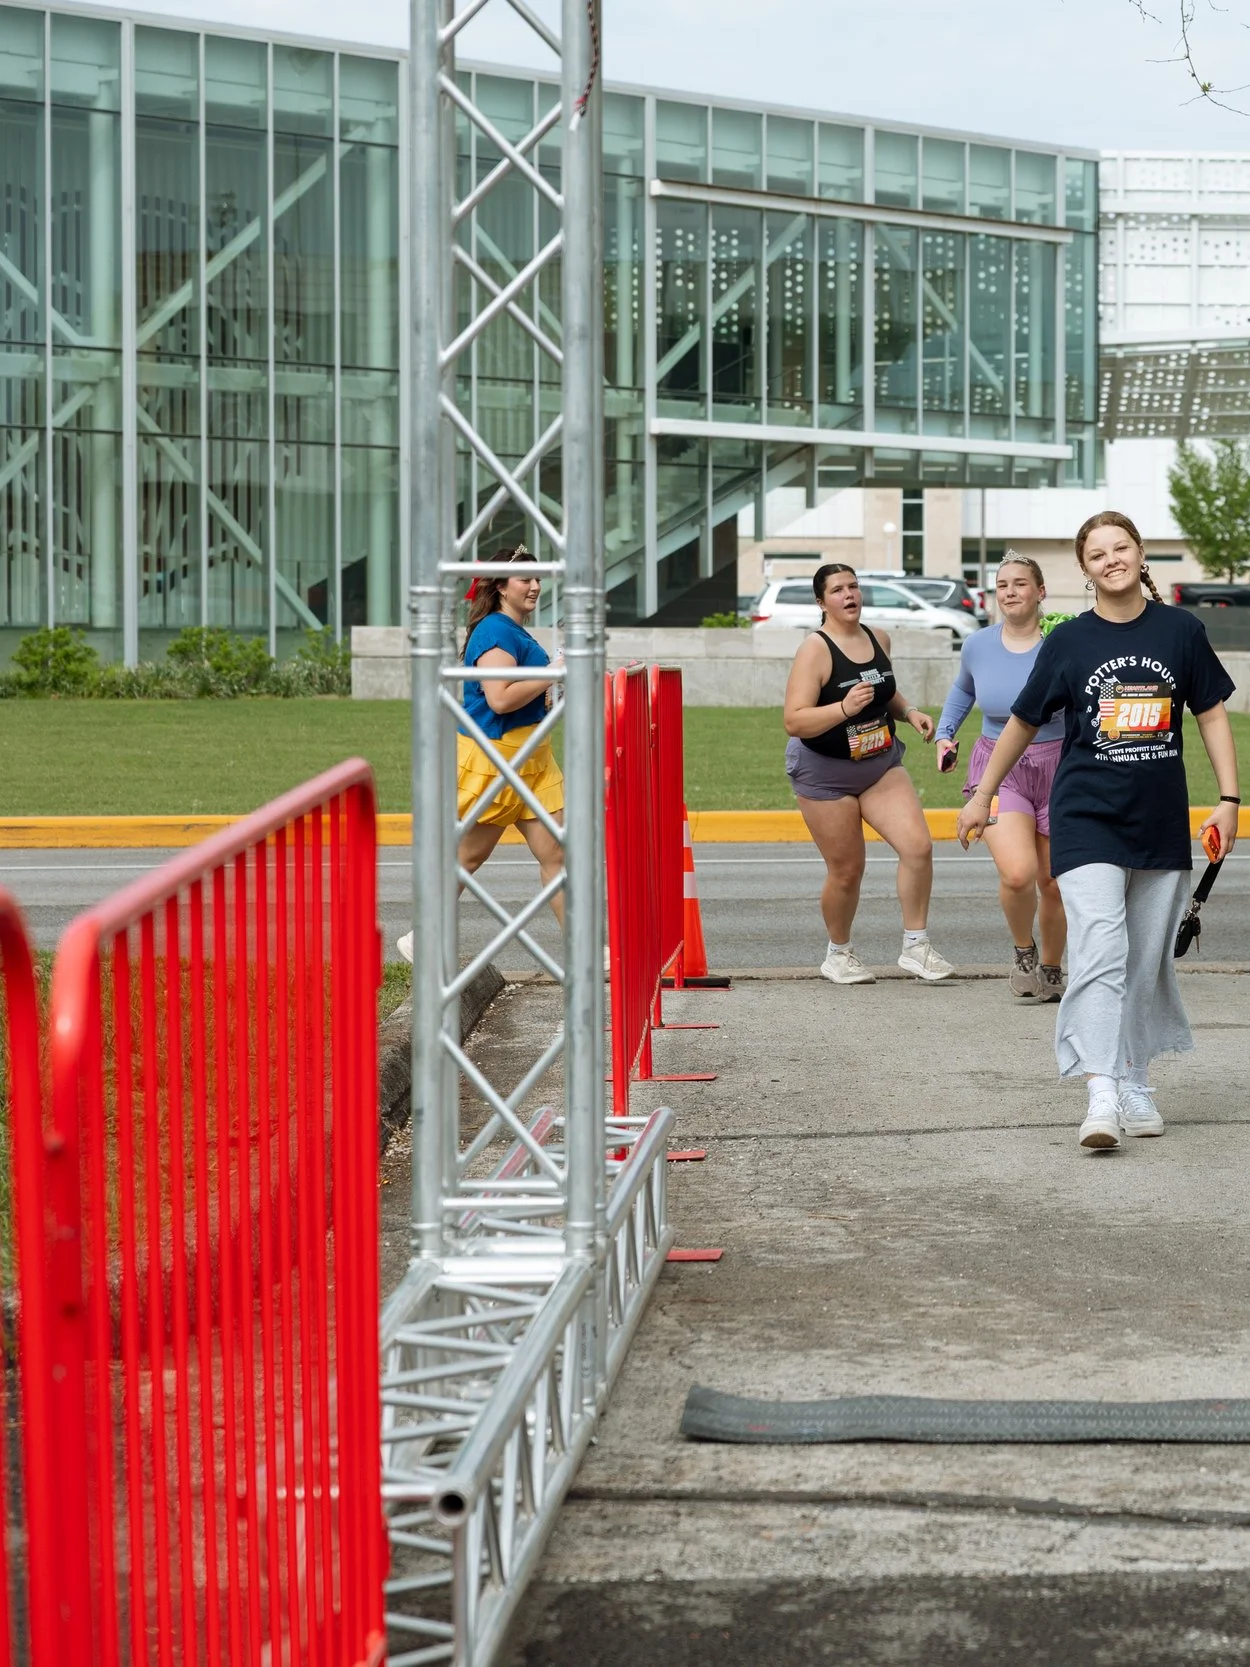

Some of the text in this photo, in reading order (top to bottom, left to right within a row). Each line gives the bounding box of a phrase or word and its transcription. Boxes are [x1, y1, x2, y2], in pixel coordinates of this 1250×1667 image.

[1085, 656, 1176, 695] POTTER'S HOUSE
[1116, 703, 1162, 727] 2015
[861, 731, 885, 752] 2213
[1094, 753, 1108, 761] 4TH
[1140, 752, 1151, 760] 5K
[1151, 751, 1157, 760] &
[1158, 750, 1168, 759] FUN
[1168, 749, 1178, 757] RUN
